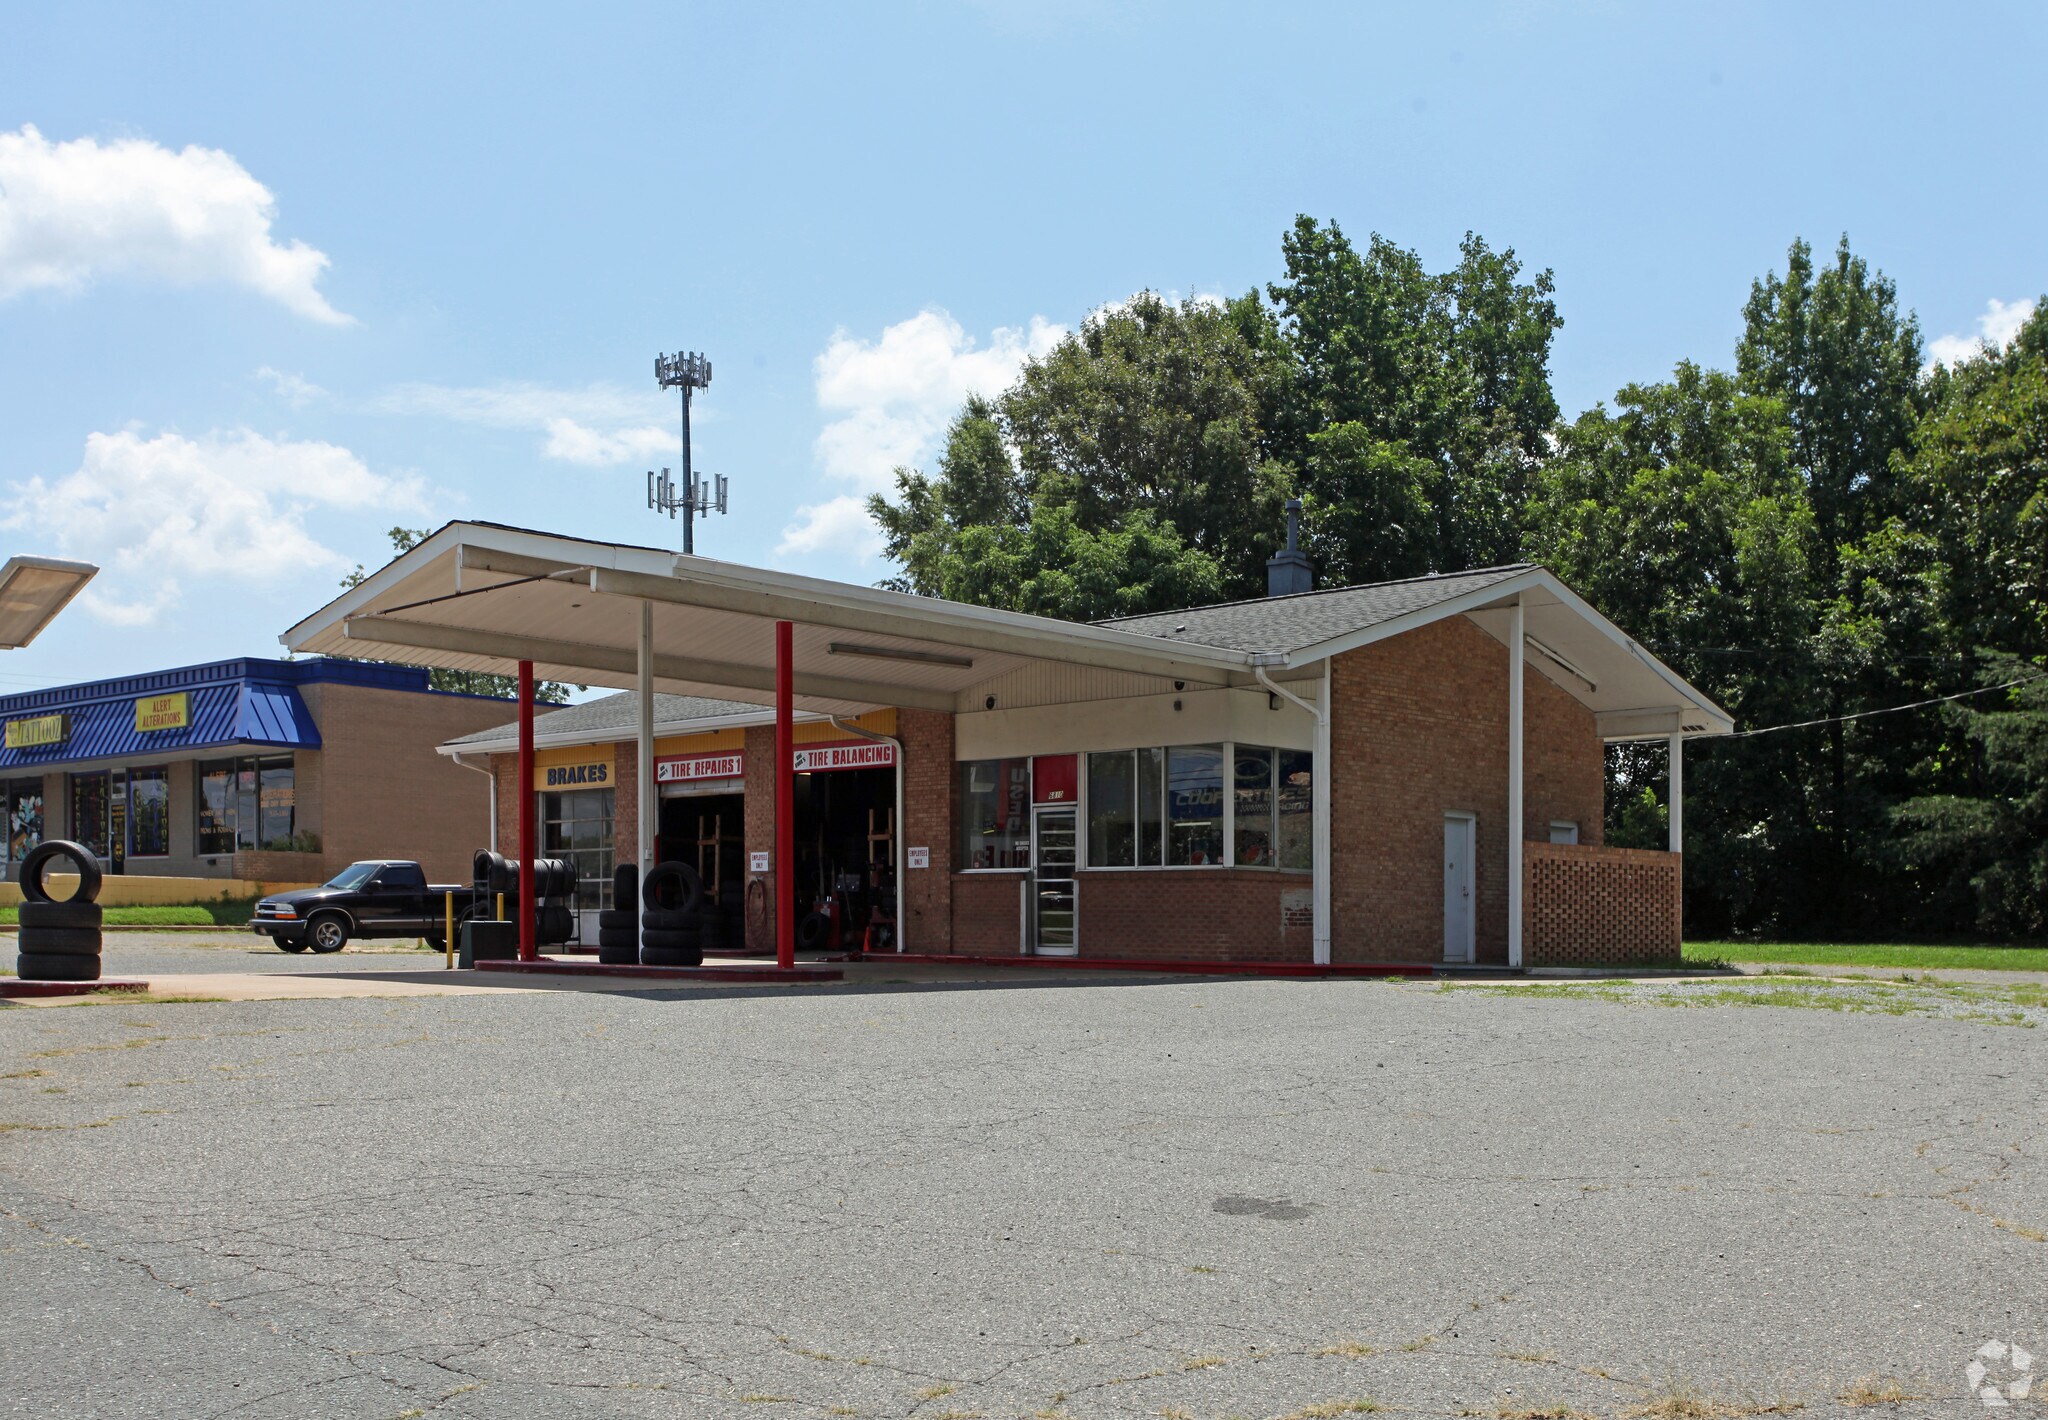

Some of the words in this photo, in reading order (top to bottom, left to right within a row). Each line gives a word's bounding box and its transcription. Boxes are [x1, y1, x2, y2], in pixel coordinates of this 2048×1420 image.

[152, 698, 171, 712] ALERT
[142, 711, 181, 728] ALTERATIONS
[20, 717, 61, 745] TATTOOZ
[808, 751, 829, 767] TIRE
[832, 746, 891, 765] BALANCING
[547, 763, 607, 786] BRAKES
[671, 762, 691, 778] TIRE
[694, 758, 734, 776] REPAIRS
